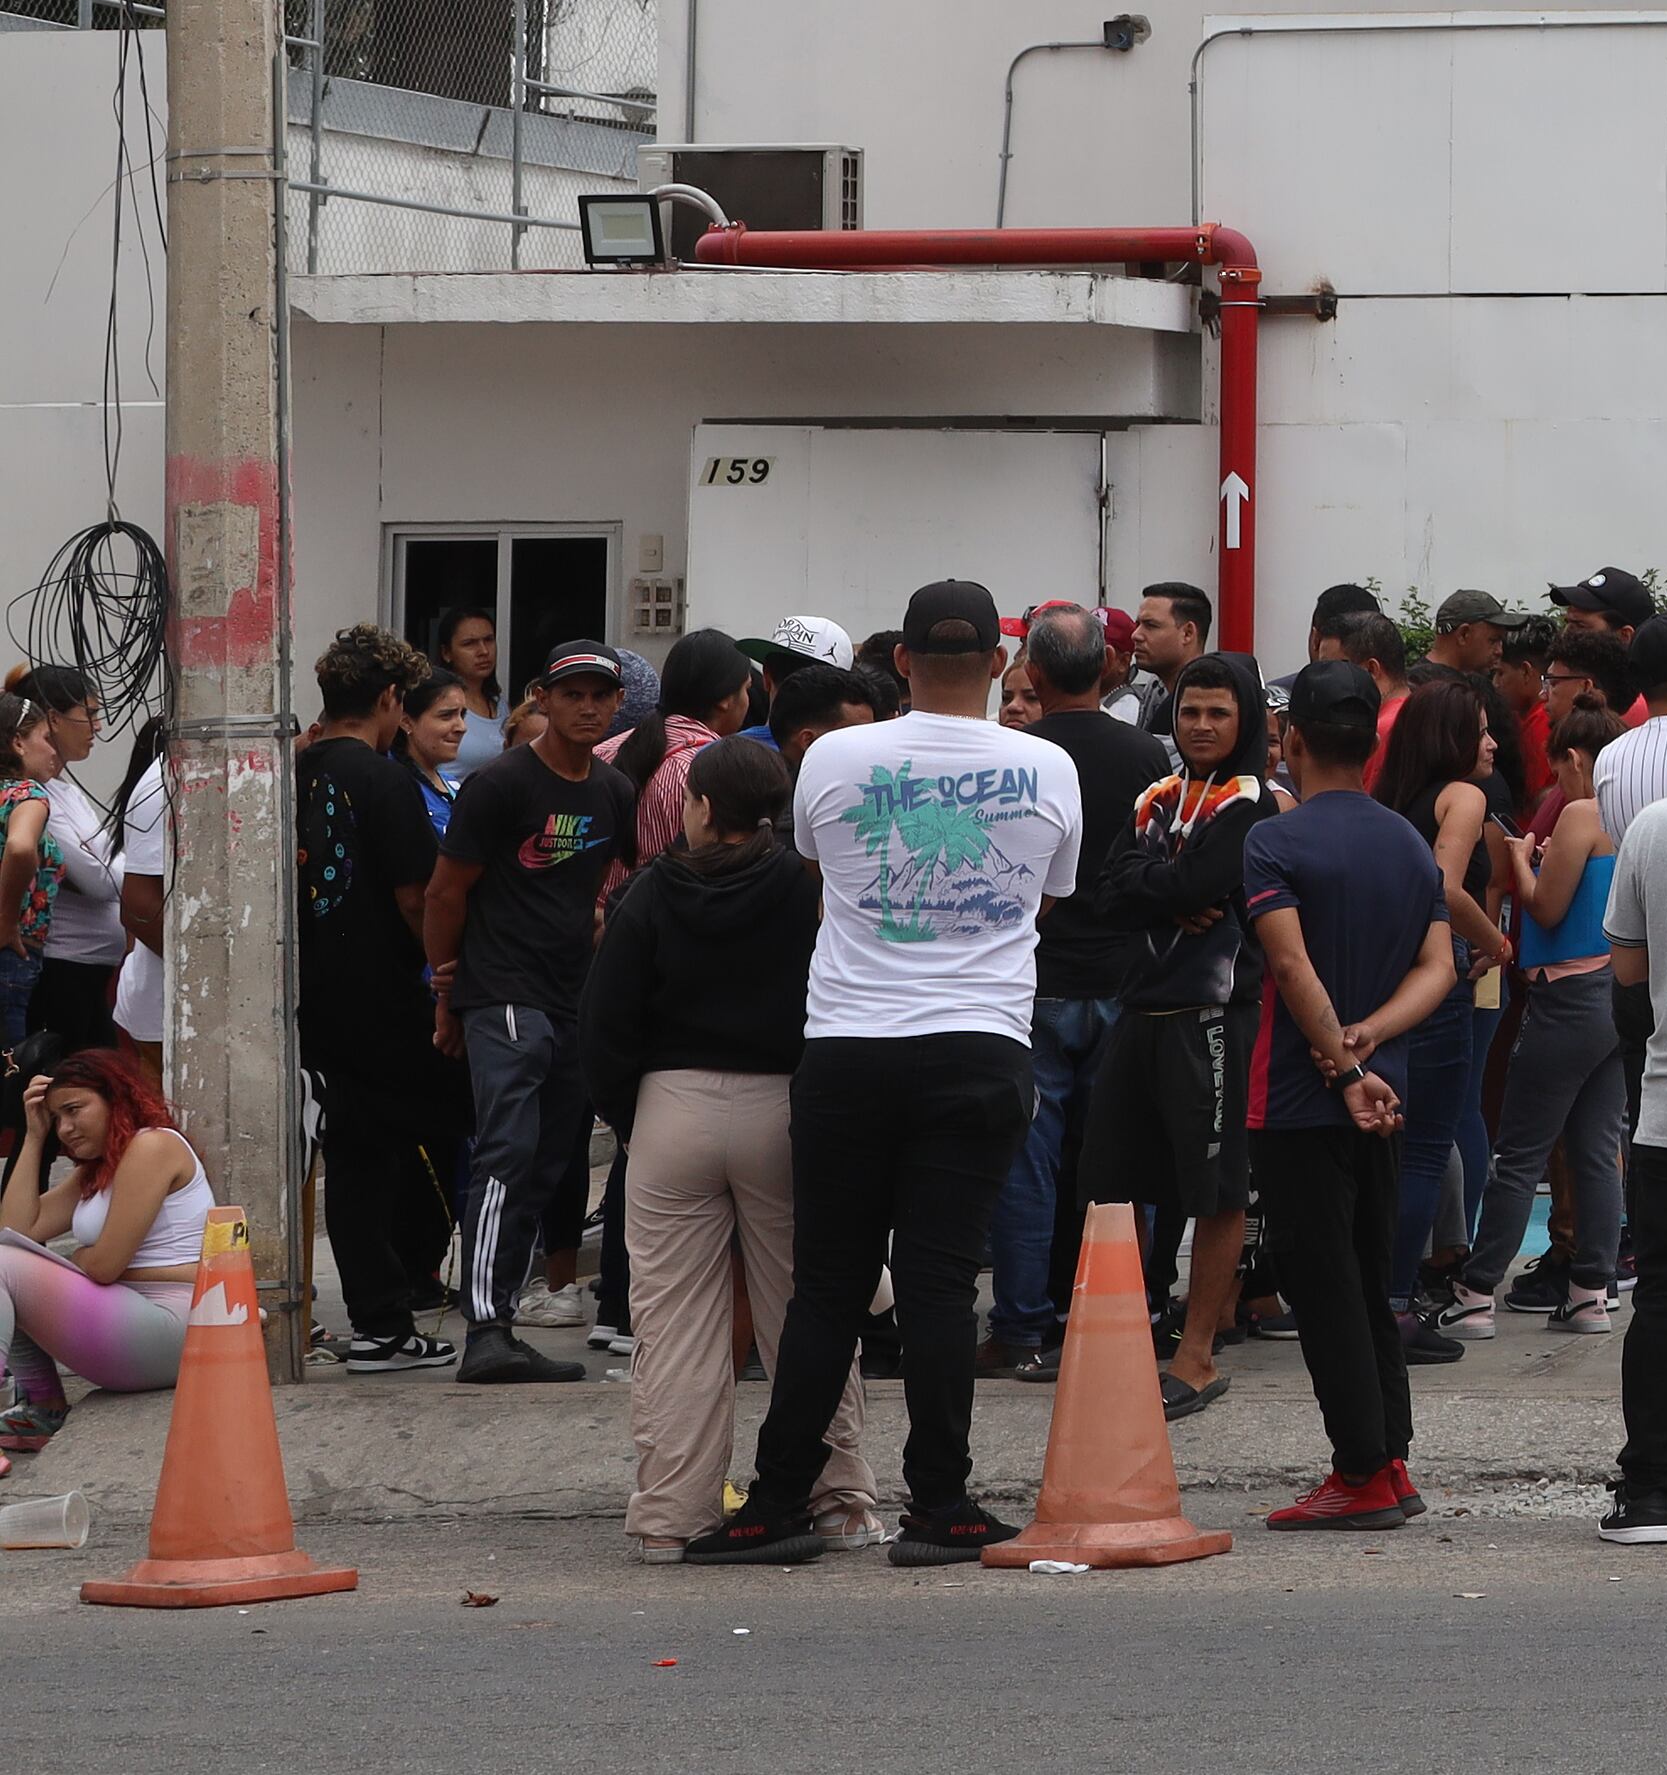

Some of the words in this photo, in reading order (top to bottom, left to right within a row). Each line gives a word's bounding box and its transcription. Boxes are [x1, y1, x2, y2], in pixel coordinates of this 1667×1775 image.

[707, 458, 770, 485] 159
[778, 618, 815, 644] ORDAN
[864, 777, 932, 817] THE
[938, 766, 1039, 809] OCEAN
[545, 814, 594, 836] NIKE
